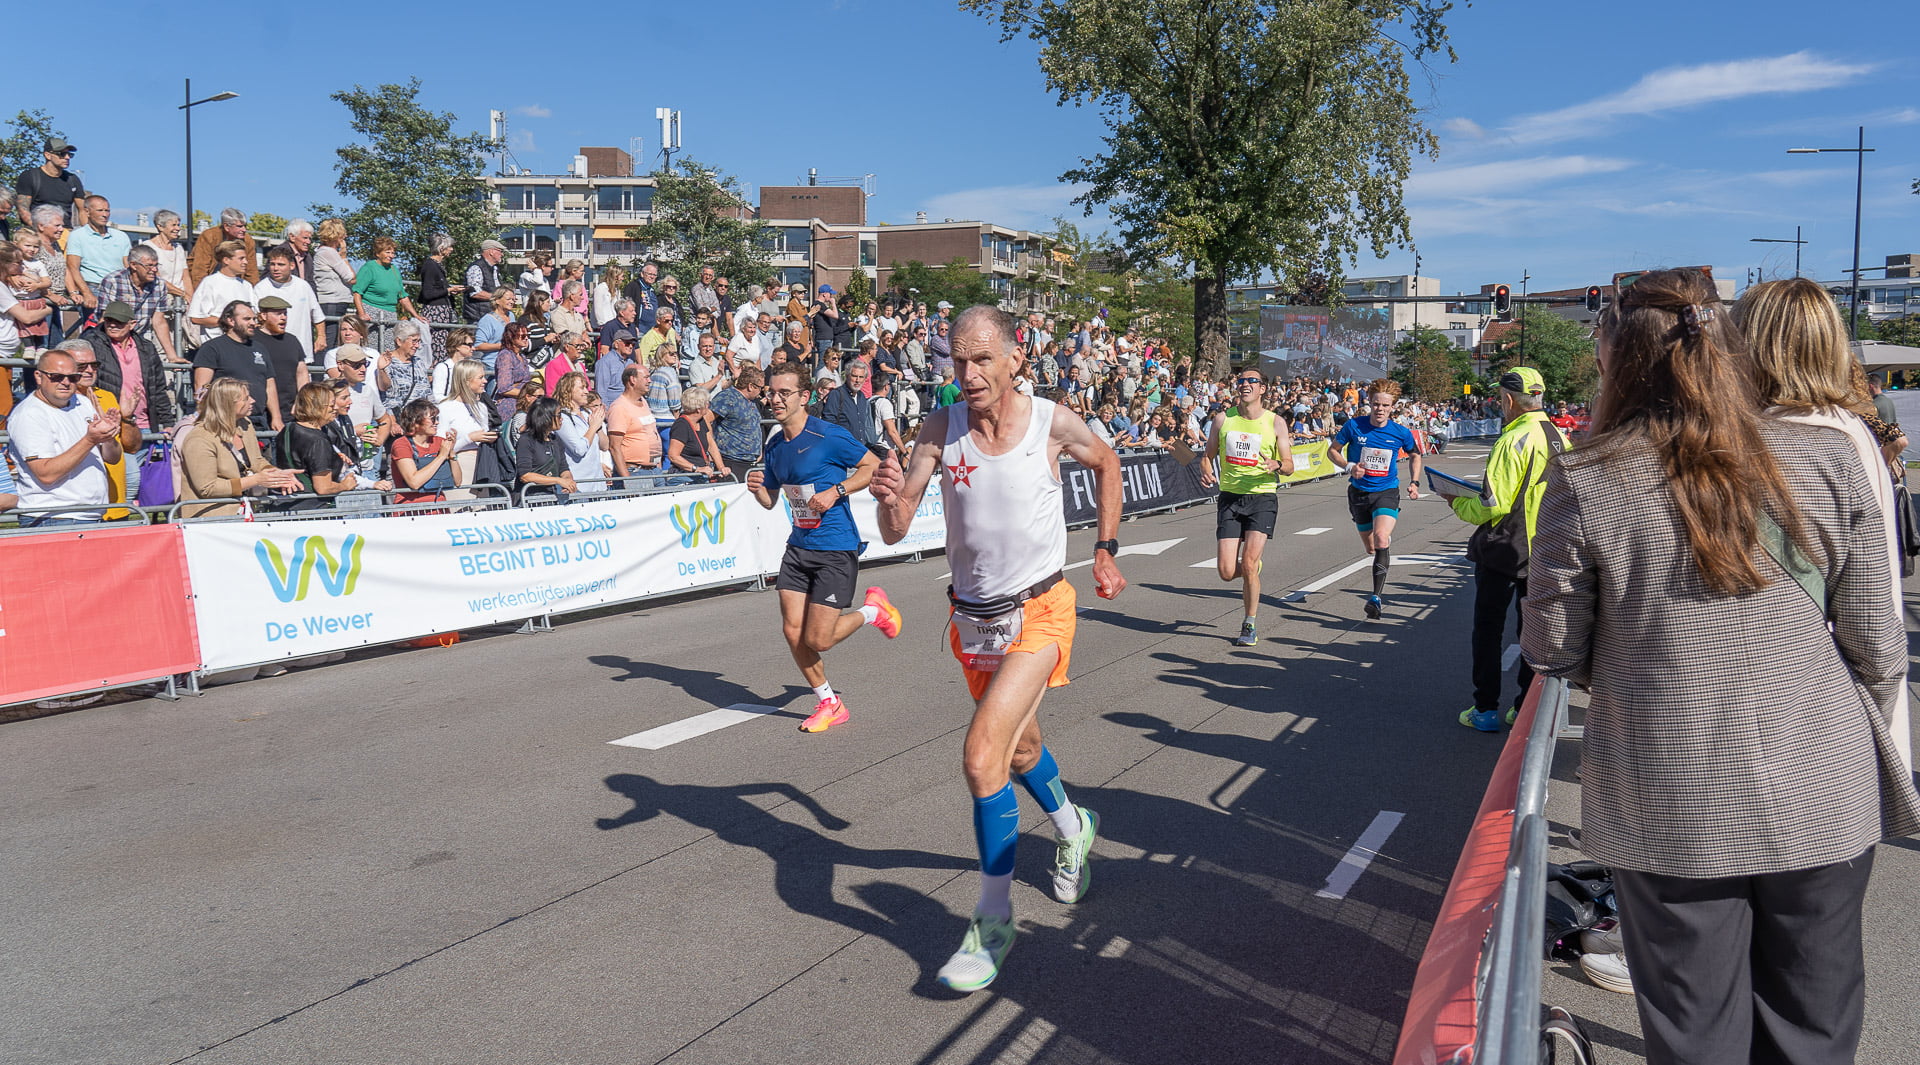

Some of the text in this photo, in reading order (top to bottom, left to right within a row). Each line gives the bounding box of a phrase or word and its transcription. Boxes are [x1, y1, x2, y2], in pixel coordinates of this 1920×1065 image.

[1235, 441, 1251, 451] TEUN
[1366, 455, 1386, 464] STEFAN
[446, 513, 617, 547] EEN NIEUWE DAG
[459, 538, 611, 576] BEGINT BIJ JOU
[677, 556, 737, 576] De Wever
[467, 573, 618, 613] werkenbijdewever.nl
[265, 612, 374, 642] De Wever
